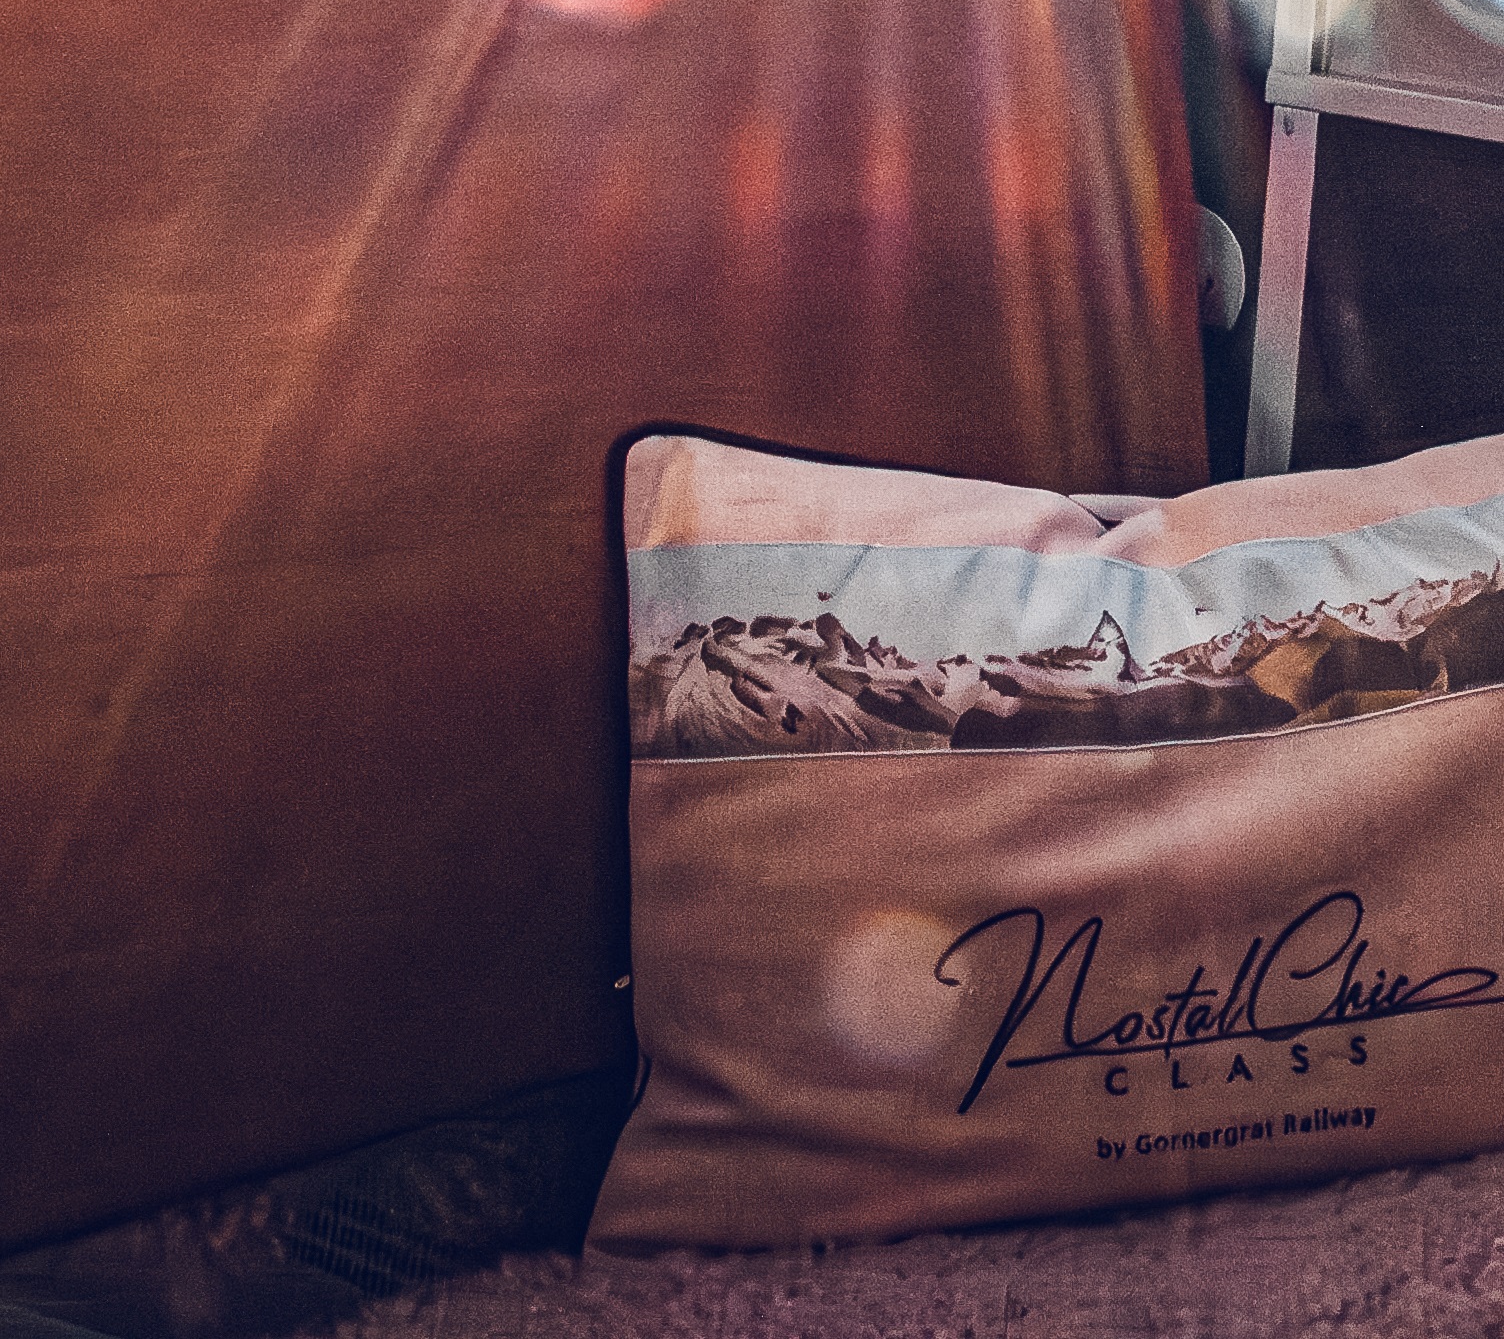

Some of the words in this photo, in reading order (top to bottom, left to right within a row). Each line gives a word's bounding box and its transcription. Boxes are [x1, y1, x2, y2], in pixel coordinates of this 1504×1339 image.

[1104, 1034, 1370, 1097] CLASS
[1096, 1134, 1126, 1162] by
[1135, 1118, 1274, 1156] Gornergrat
[1283, 1106, 1378, 1136] Railway
